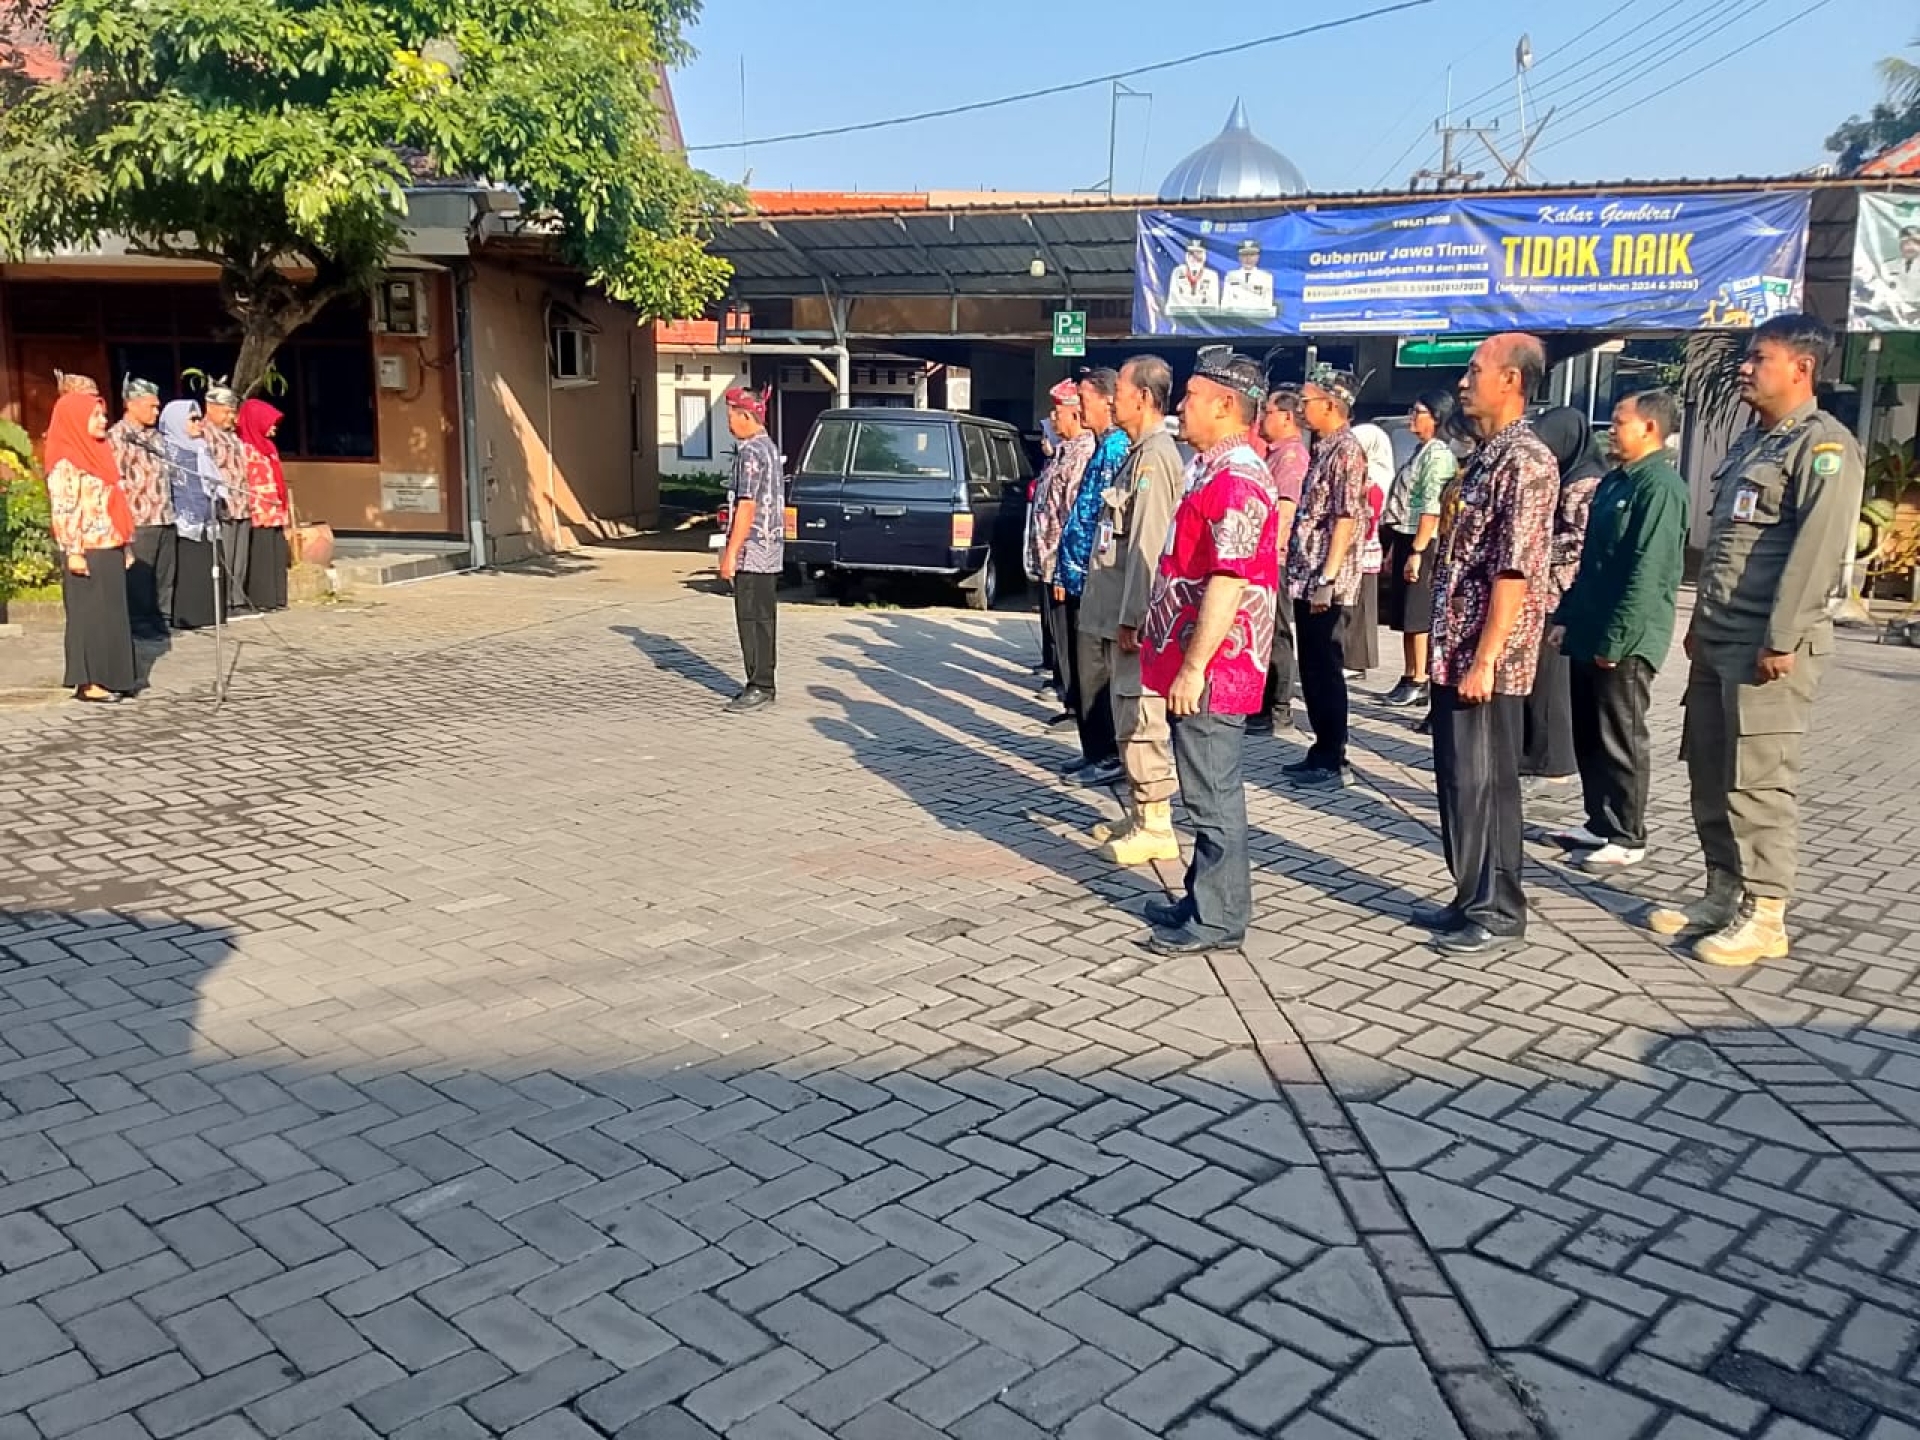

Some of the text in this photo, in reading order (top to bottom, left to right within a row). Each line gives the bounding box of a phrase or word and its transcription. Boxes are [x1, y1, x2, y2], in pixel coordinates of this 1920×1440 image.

[1537, 202, 1684, 228] Kabar Gembira!
[1309, 242, 1488, 266] Gubernur Jawa Timur
[1502, 232, 1695, 277] TIDAK NAIK
